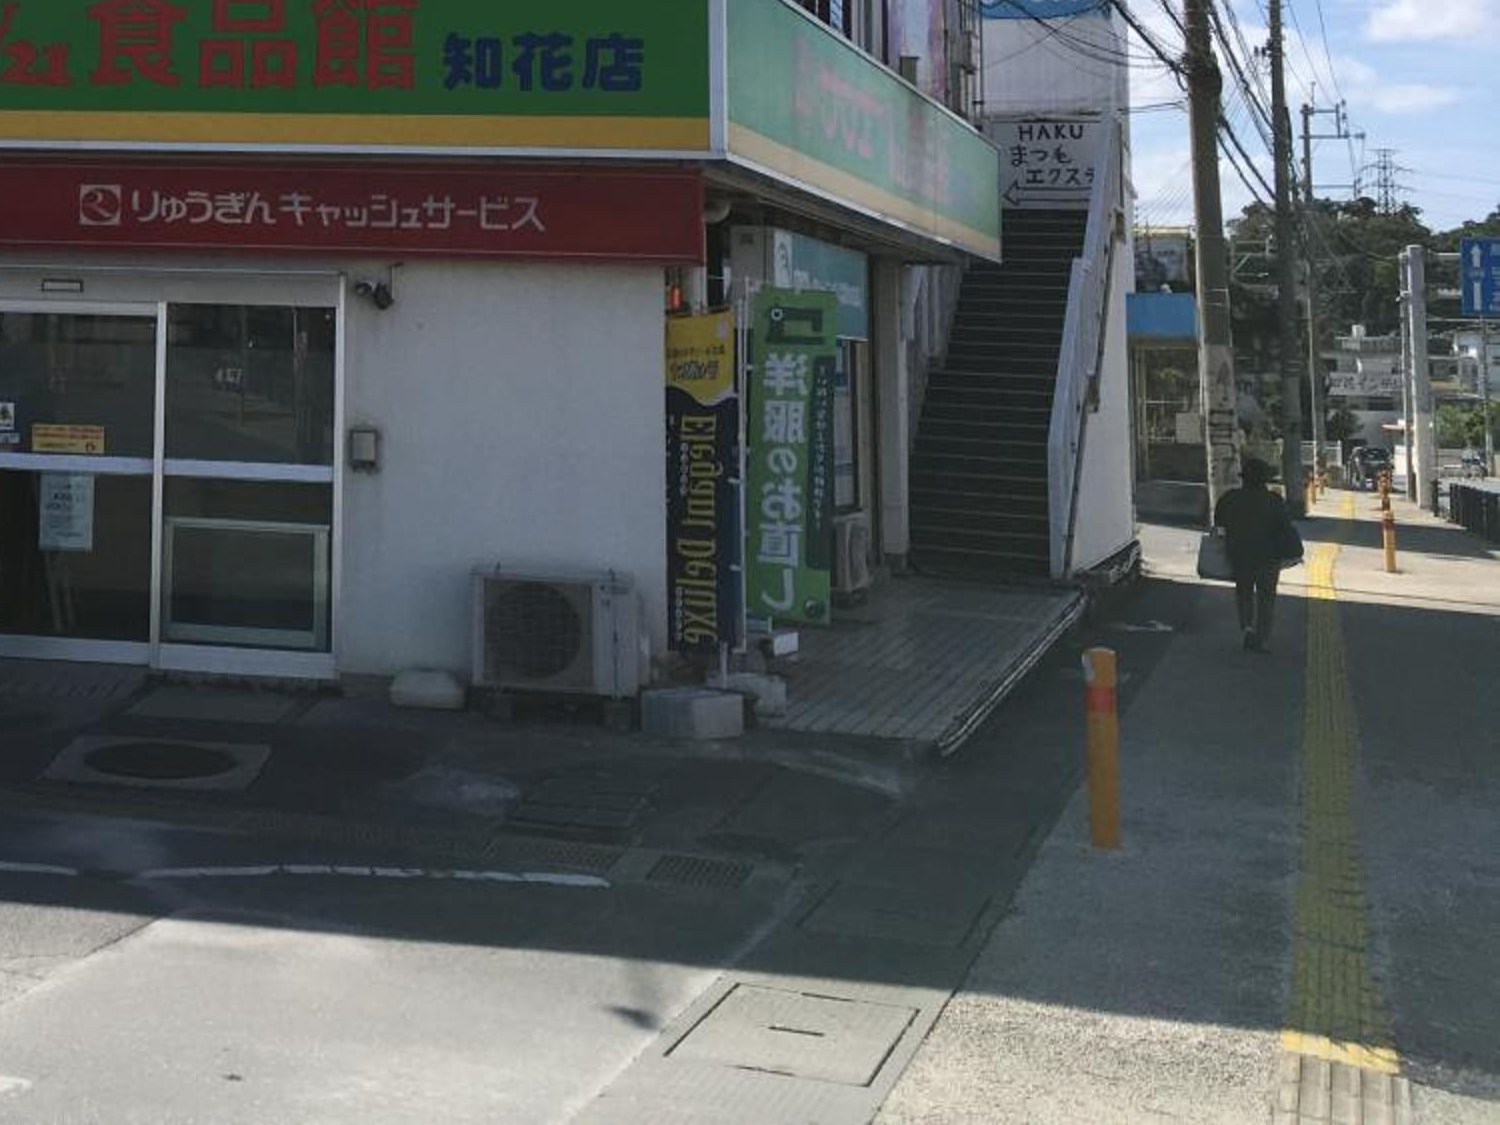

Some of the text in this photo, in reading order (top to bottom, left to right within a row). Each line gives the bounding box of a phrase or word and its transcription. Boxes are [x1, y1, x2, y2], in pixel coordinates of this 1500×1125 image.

[442, 32, 645, 92] 知花店
[1018, 124, 1084, 141] HAKU
